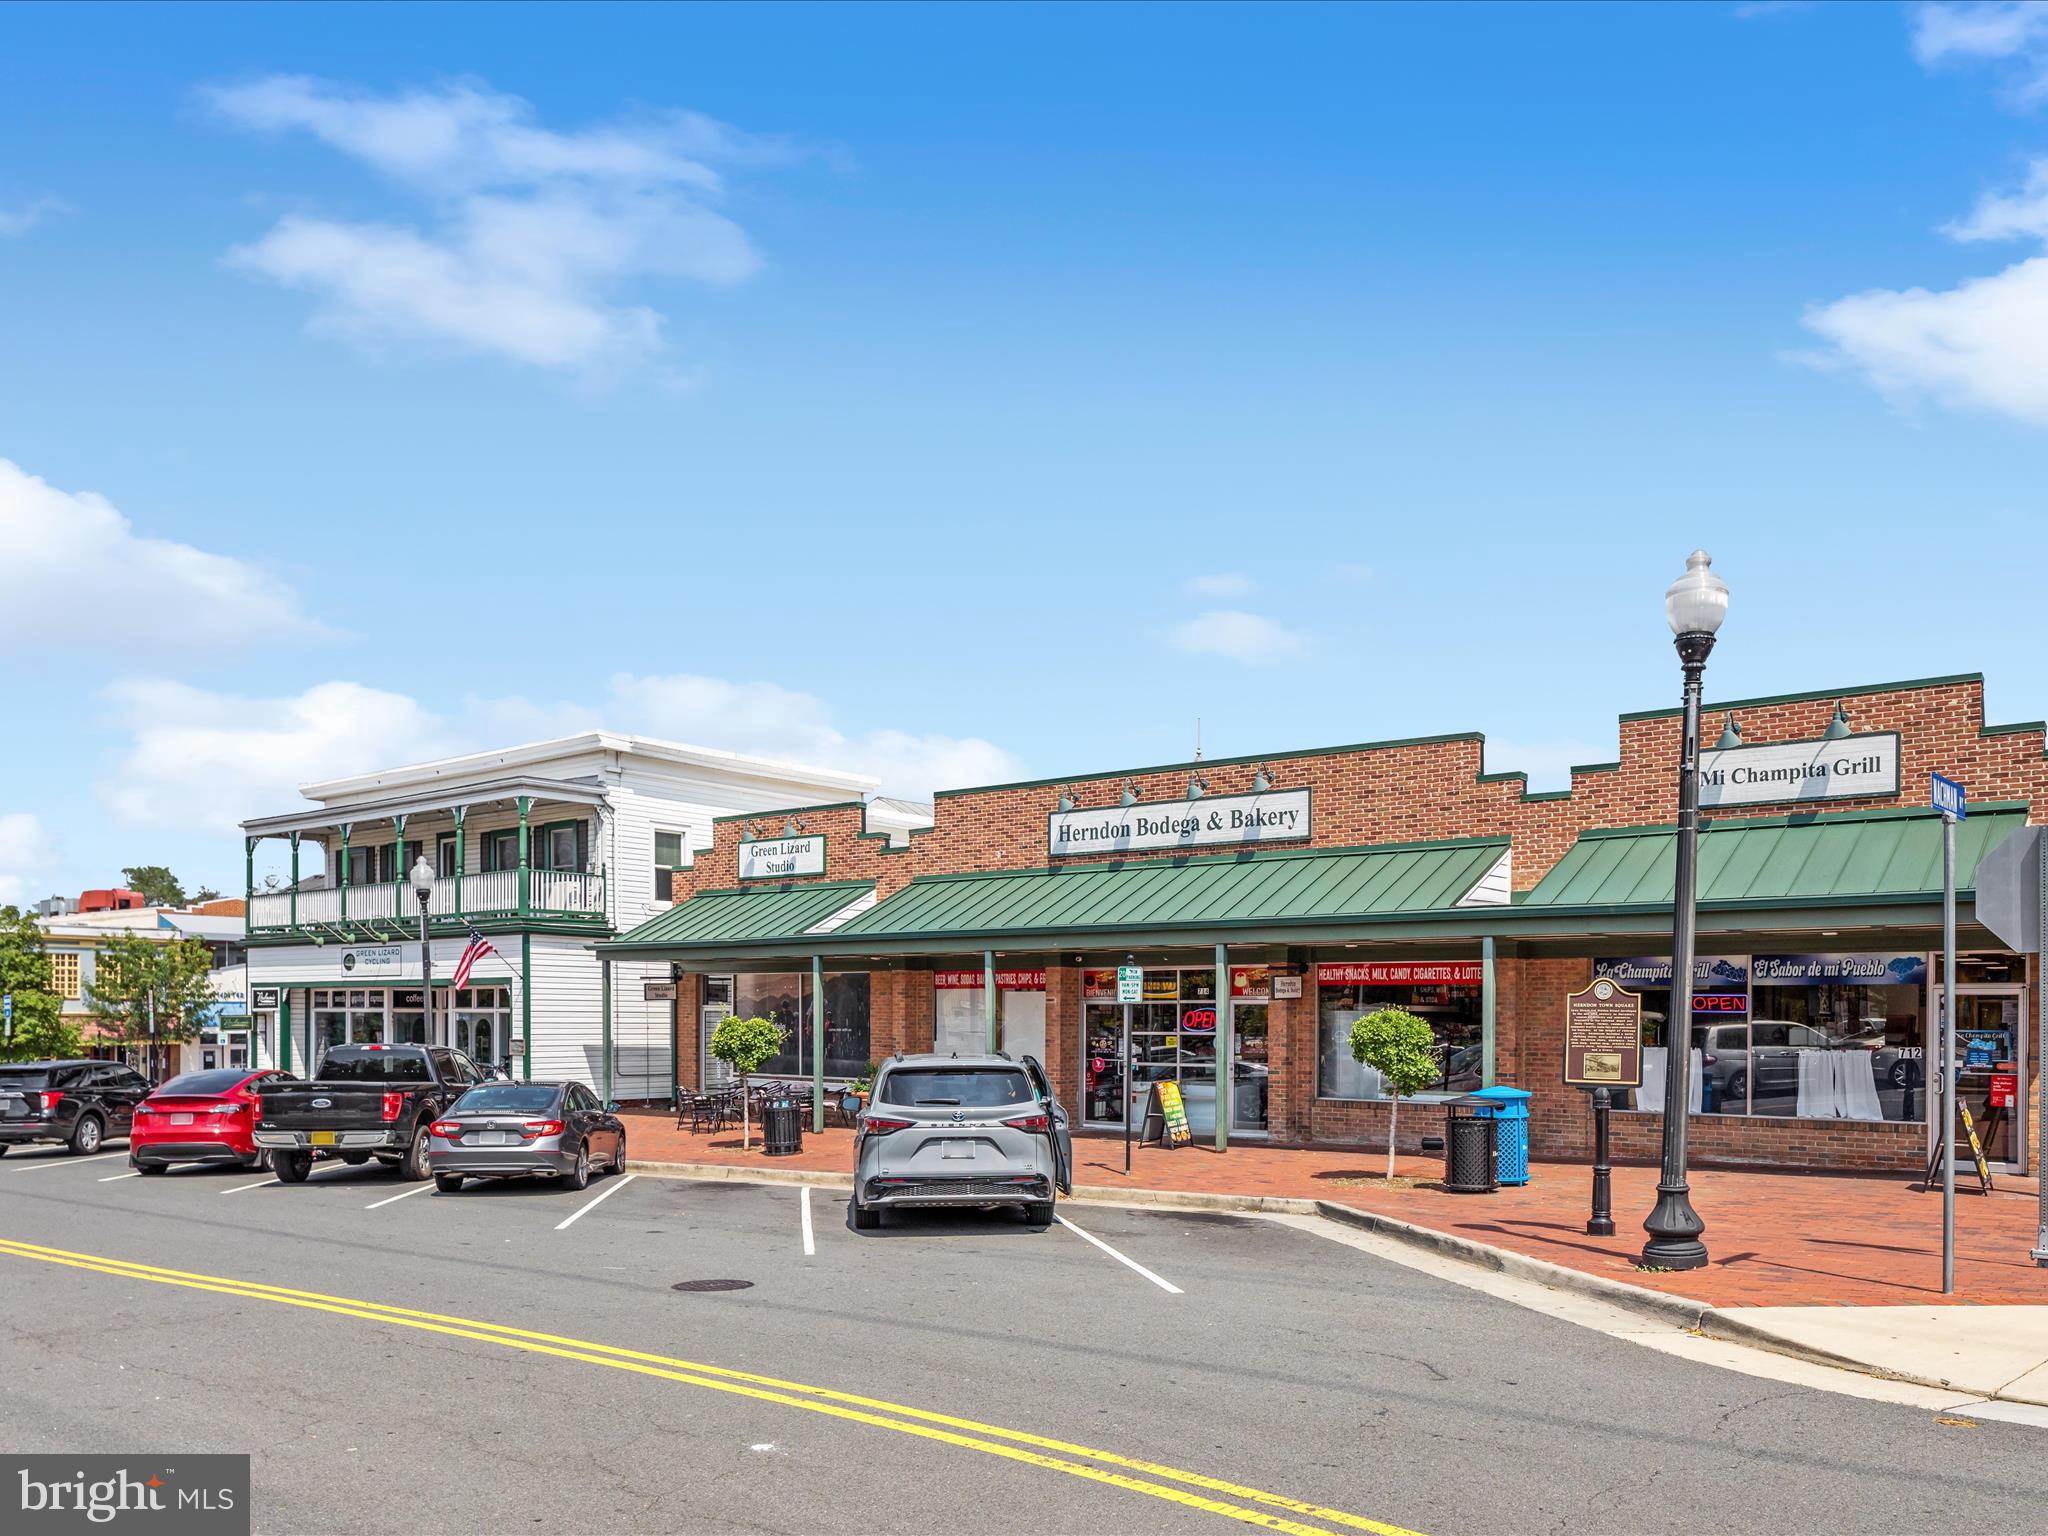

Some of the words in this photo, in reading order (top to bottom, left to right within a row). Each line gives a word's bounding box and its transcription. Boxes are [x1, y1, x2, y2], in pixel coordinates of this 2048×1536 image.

[1700, 769, 1725, 787] Mi
[1731, 762, 1827, 784] Champita
[1833, 756, 1881, 776] Grill
[1057, 822, 1131, 843] Herndon
[1135, 816, 1201, 838] Bodega
[1206, 810, 1223, 831] &
[1230, 808, 1300, 829] Bakery
[751, 845, 778, 857] Green
[780, 840, 811, 855] Lizard
[766, 860, 795, 873] Studio
[356, 949, 376, 957] GREEN
[378, 948, 400, 956] LIZARD
[364, 957, 391, 965] CYCLING
[1318, 968, 1344, 980] HEALTHY
[1454, 967, 1461, 980] &
[1754, 959, 1769, 978] El
[1769, 959, 1806, 978] Sabor
[1807, 960, 1821, 977] de
[1824, 960, 1841, 977] mi
[1841, 958, 1885, 977] Pueblo
[1033, 973, 1040, 984] &
[405, 993, 424, 1003] coffee
[1693, 997, 1745, 1010] OPEN
[1184, 1011, 1216, 1028] OPEN
[1900, 1047, 1921, 1058] 712
